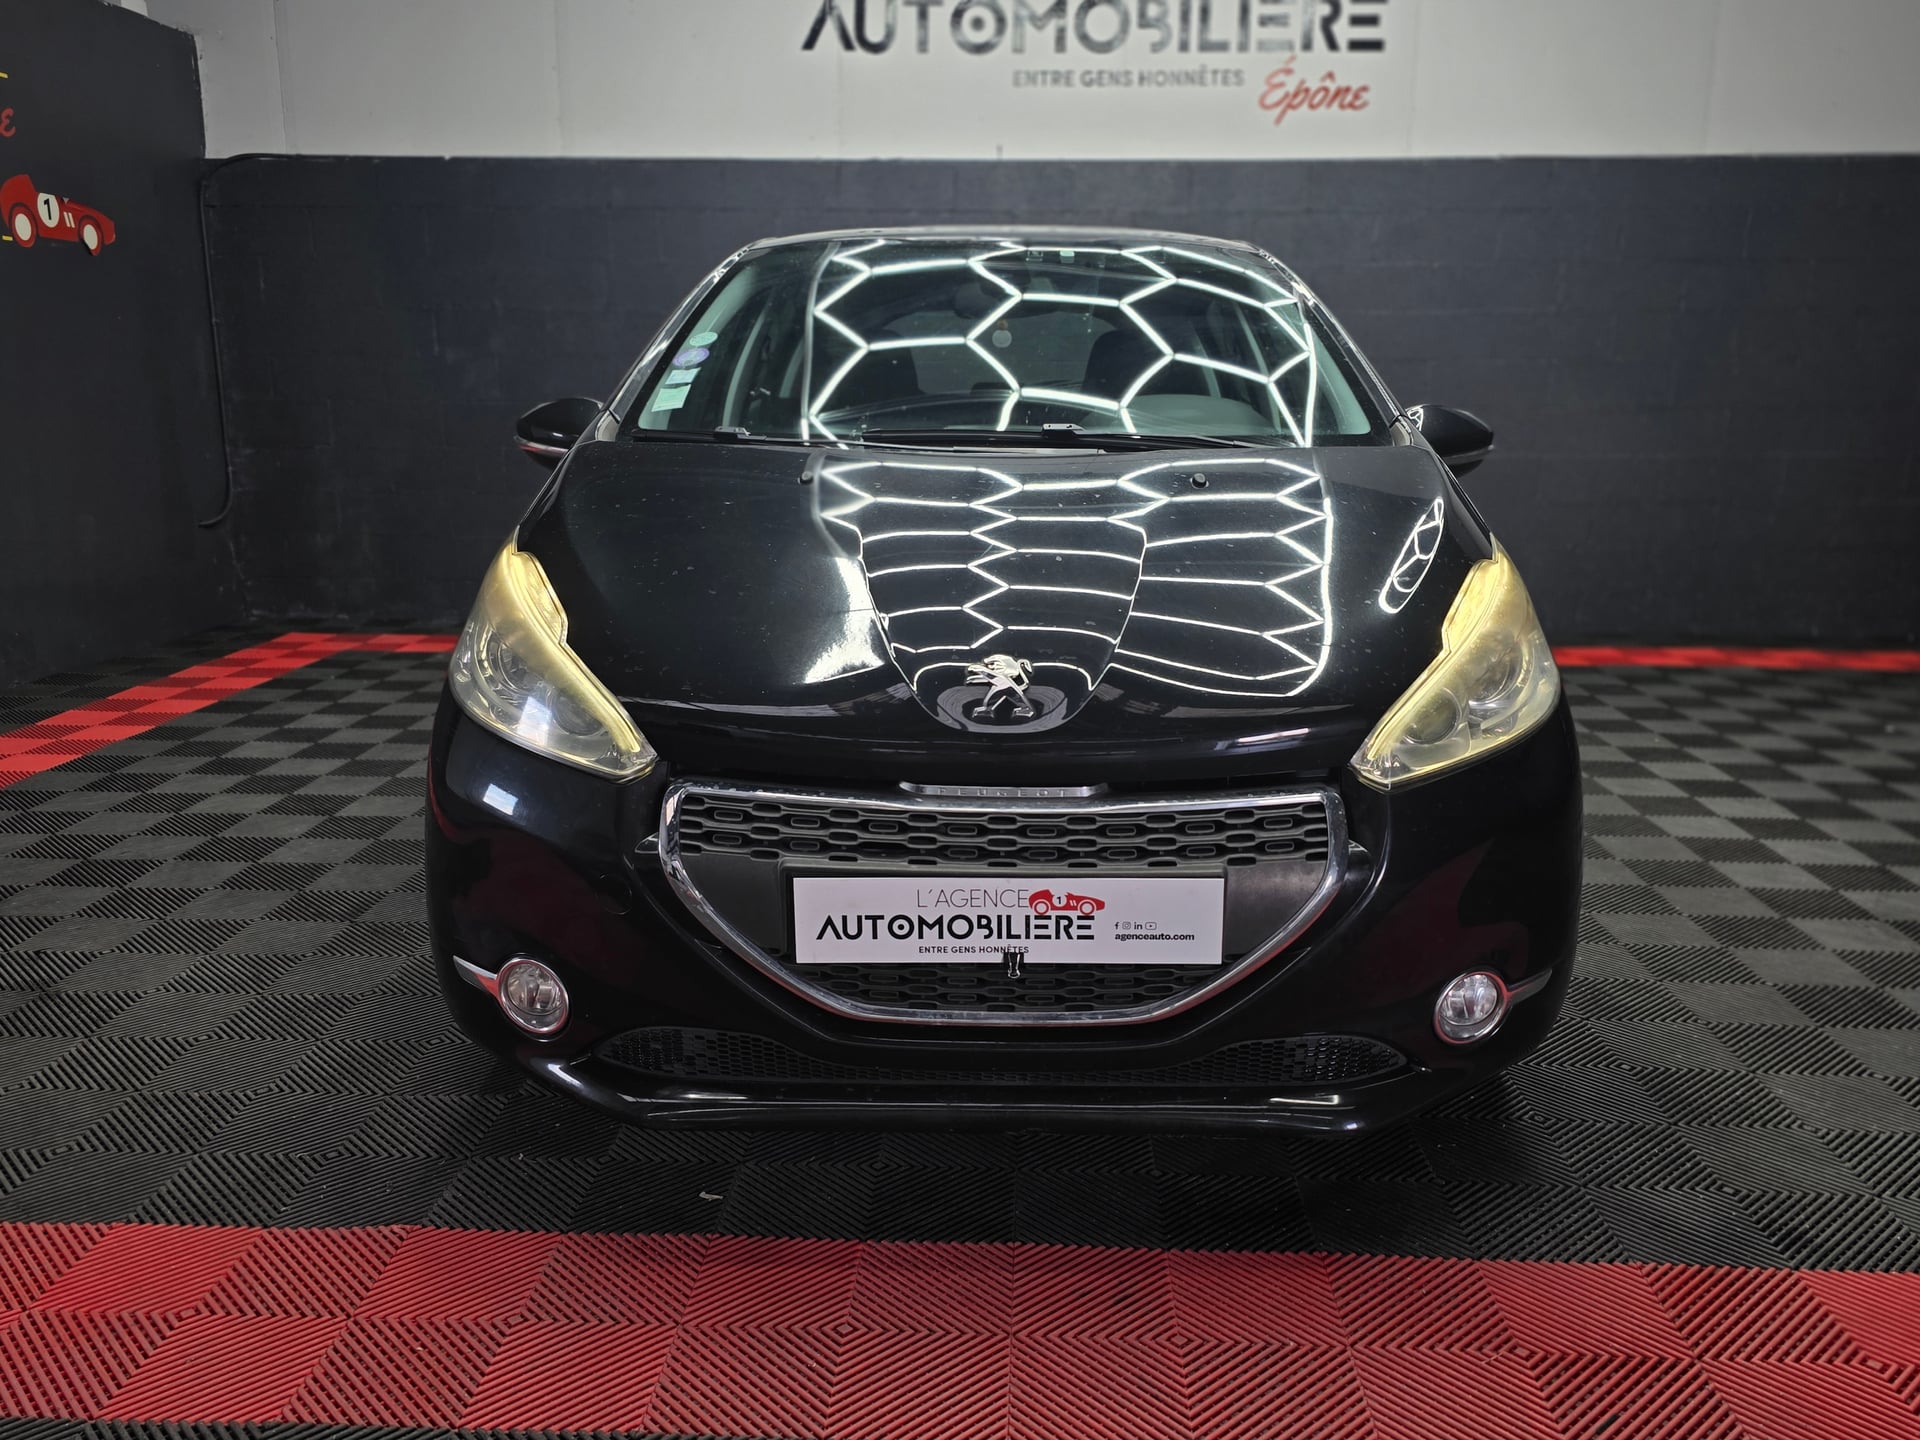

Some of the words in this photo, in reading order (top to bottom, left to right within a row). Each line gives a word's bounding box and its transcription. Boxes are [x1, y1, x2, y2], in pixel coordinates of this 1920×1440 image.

[1012, 69, 1075, 88] ENTRE
[1079, 69, 1134, 88] GENS
[1137, 64, 1245, 88] HONNÊTES
[1258, 56, 1370, 125] Épône
[917, 888, 1029, 908] L'AGENCE
[816, 914, 1095, 940] AUTOMOBILIERE
[1114, 933, 1195, 942] agenceauto.com
[918, 946, 949, 954] ENTRE
[950, 946, 976, 954] GENS
[979, 944, 1030, 954] HONNÊTES
